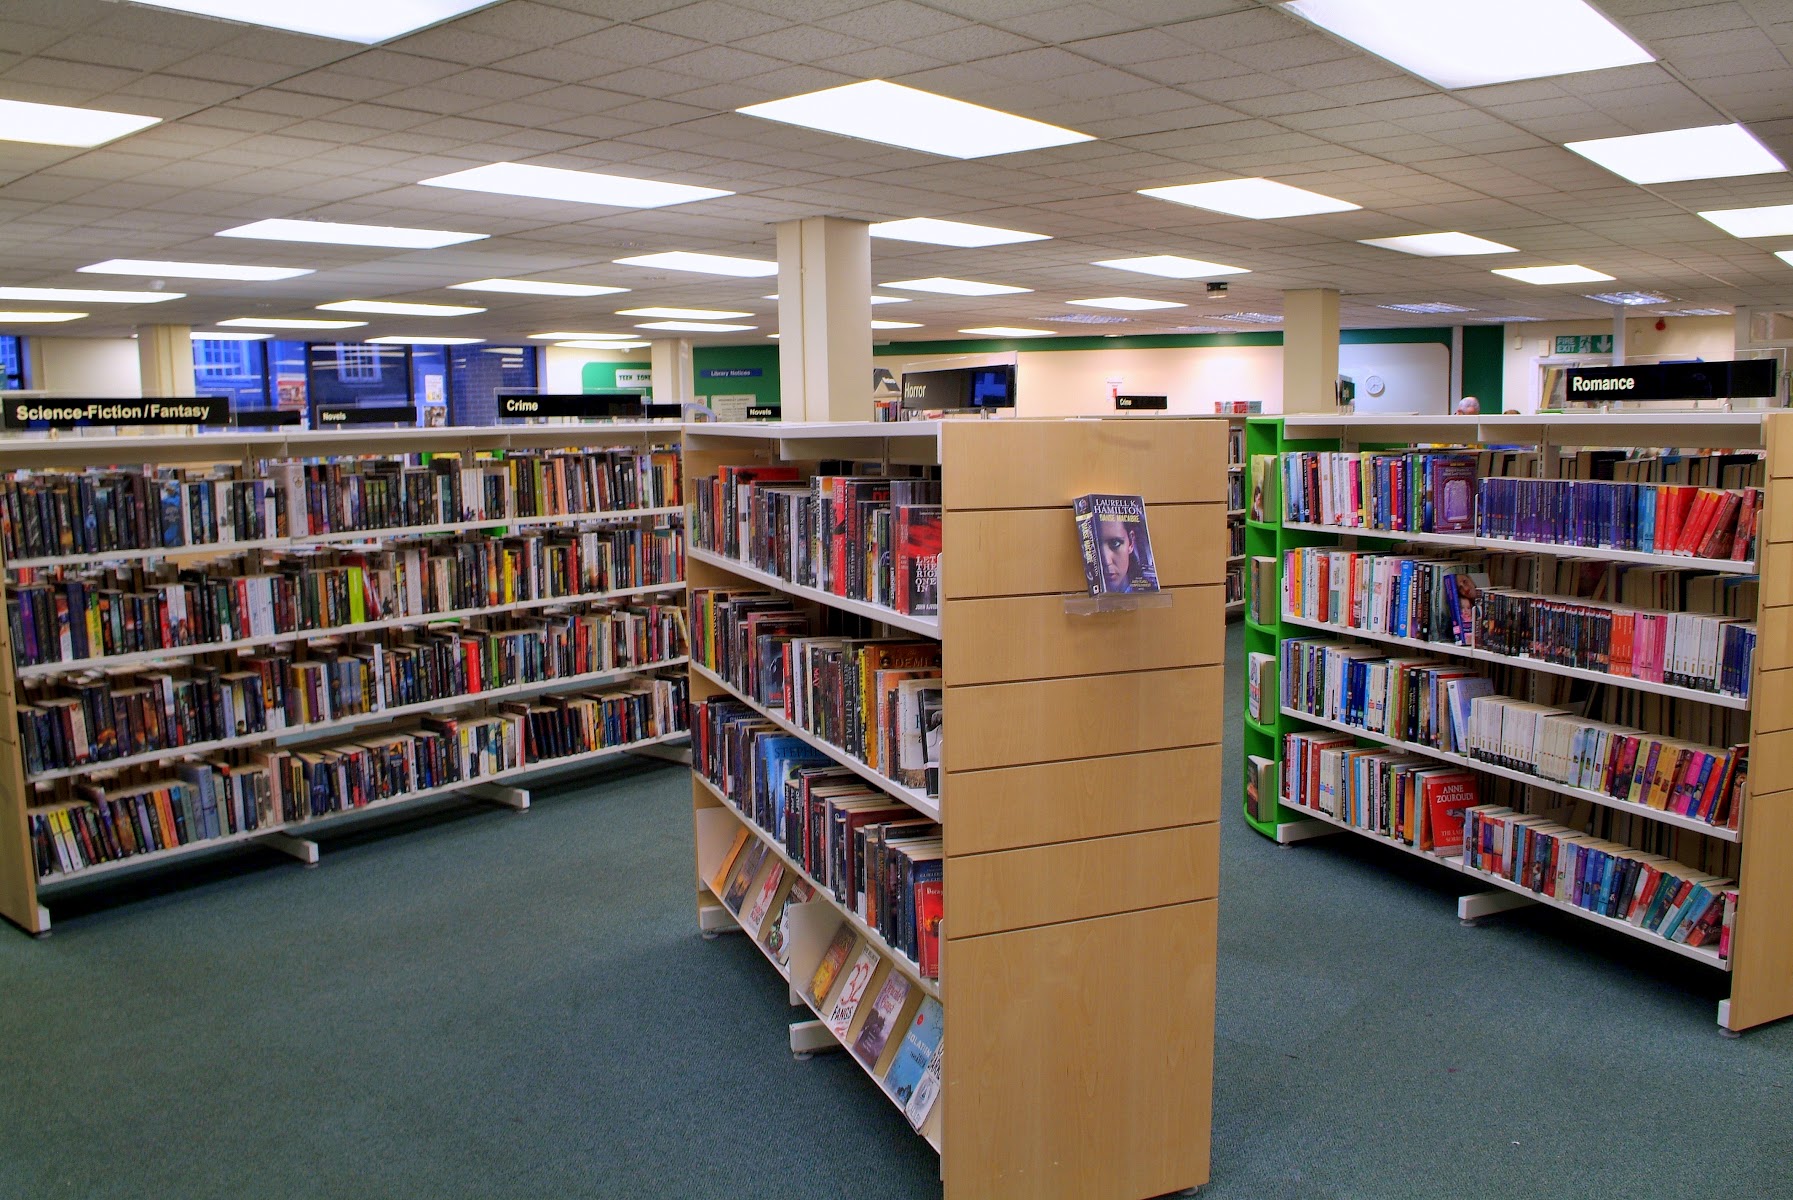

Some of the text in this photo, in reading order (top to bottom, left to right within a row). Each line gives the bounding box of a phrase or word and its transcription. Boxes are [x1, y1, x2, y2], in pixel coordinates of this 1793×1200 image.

[1557, 337, 1576, 345] FIRE
[1557, 345, 1575, 353] EXIT
[1573, 376, 1635, 391] Romance
[904, 383, 926, 398] Horror
[506, 400, 539, 412] Crime
[322, 411, 346, 421] Novels
[750, 408, 772, 416] Novels
[1096, 499, 1129, 507] LAURELL
[1094, 505, 1142, 514] HAMILTON
[916, 555, 936, 563] LET
[845, 700, 853, 741] RITUAL
[1443, 784, 1464, 794] ANNE
[1436, 792, 1474, 803] ZOUROUDI
